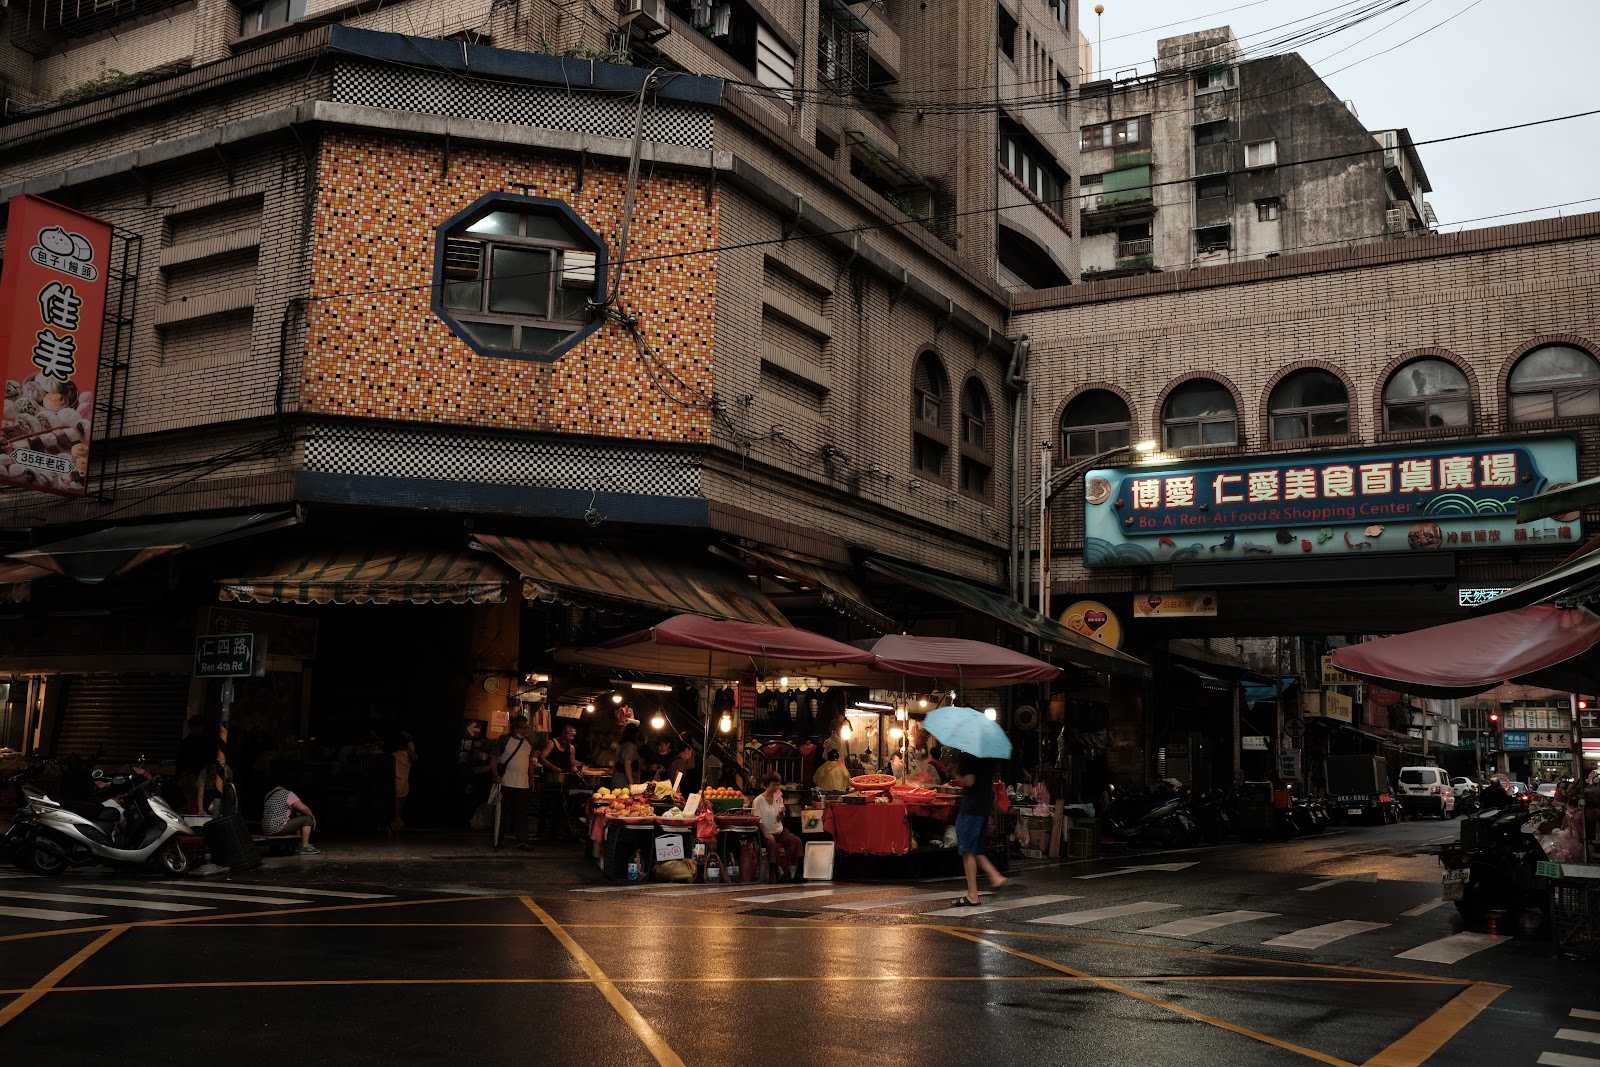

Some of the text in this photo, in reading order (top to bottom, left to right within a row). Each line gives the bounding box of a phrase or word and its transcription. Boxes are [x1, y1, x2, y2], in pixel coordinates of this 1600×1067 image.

[37, 250, 92, 278] 包子 饅頭
[34, 281, 83, 382] 佳美
[20, 452, 67, 472] 35年老店
[1131, 452, 1518, 510] 博愛 仁愛美食百貨廣場
[1138, 501, 1413, 528] Bo-Ai Ren-Ai Food & Shopping Center
[1446, 529, 1501, 544] 冷氣開放
[201, 637, 247, 656] 仁四路
[201, 662, 215, 672] Ren
[216, 661, 231, 671] 4th
